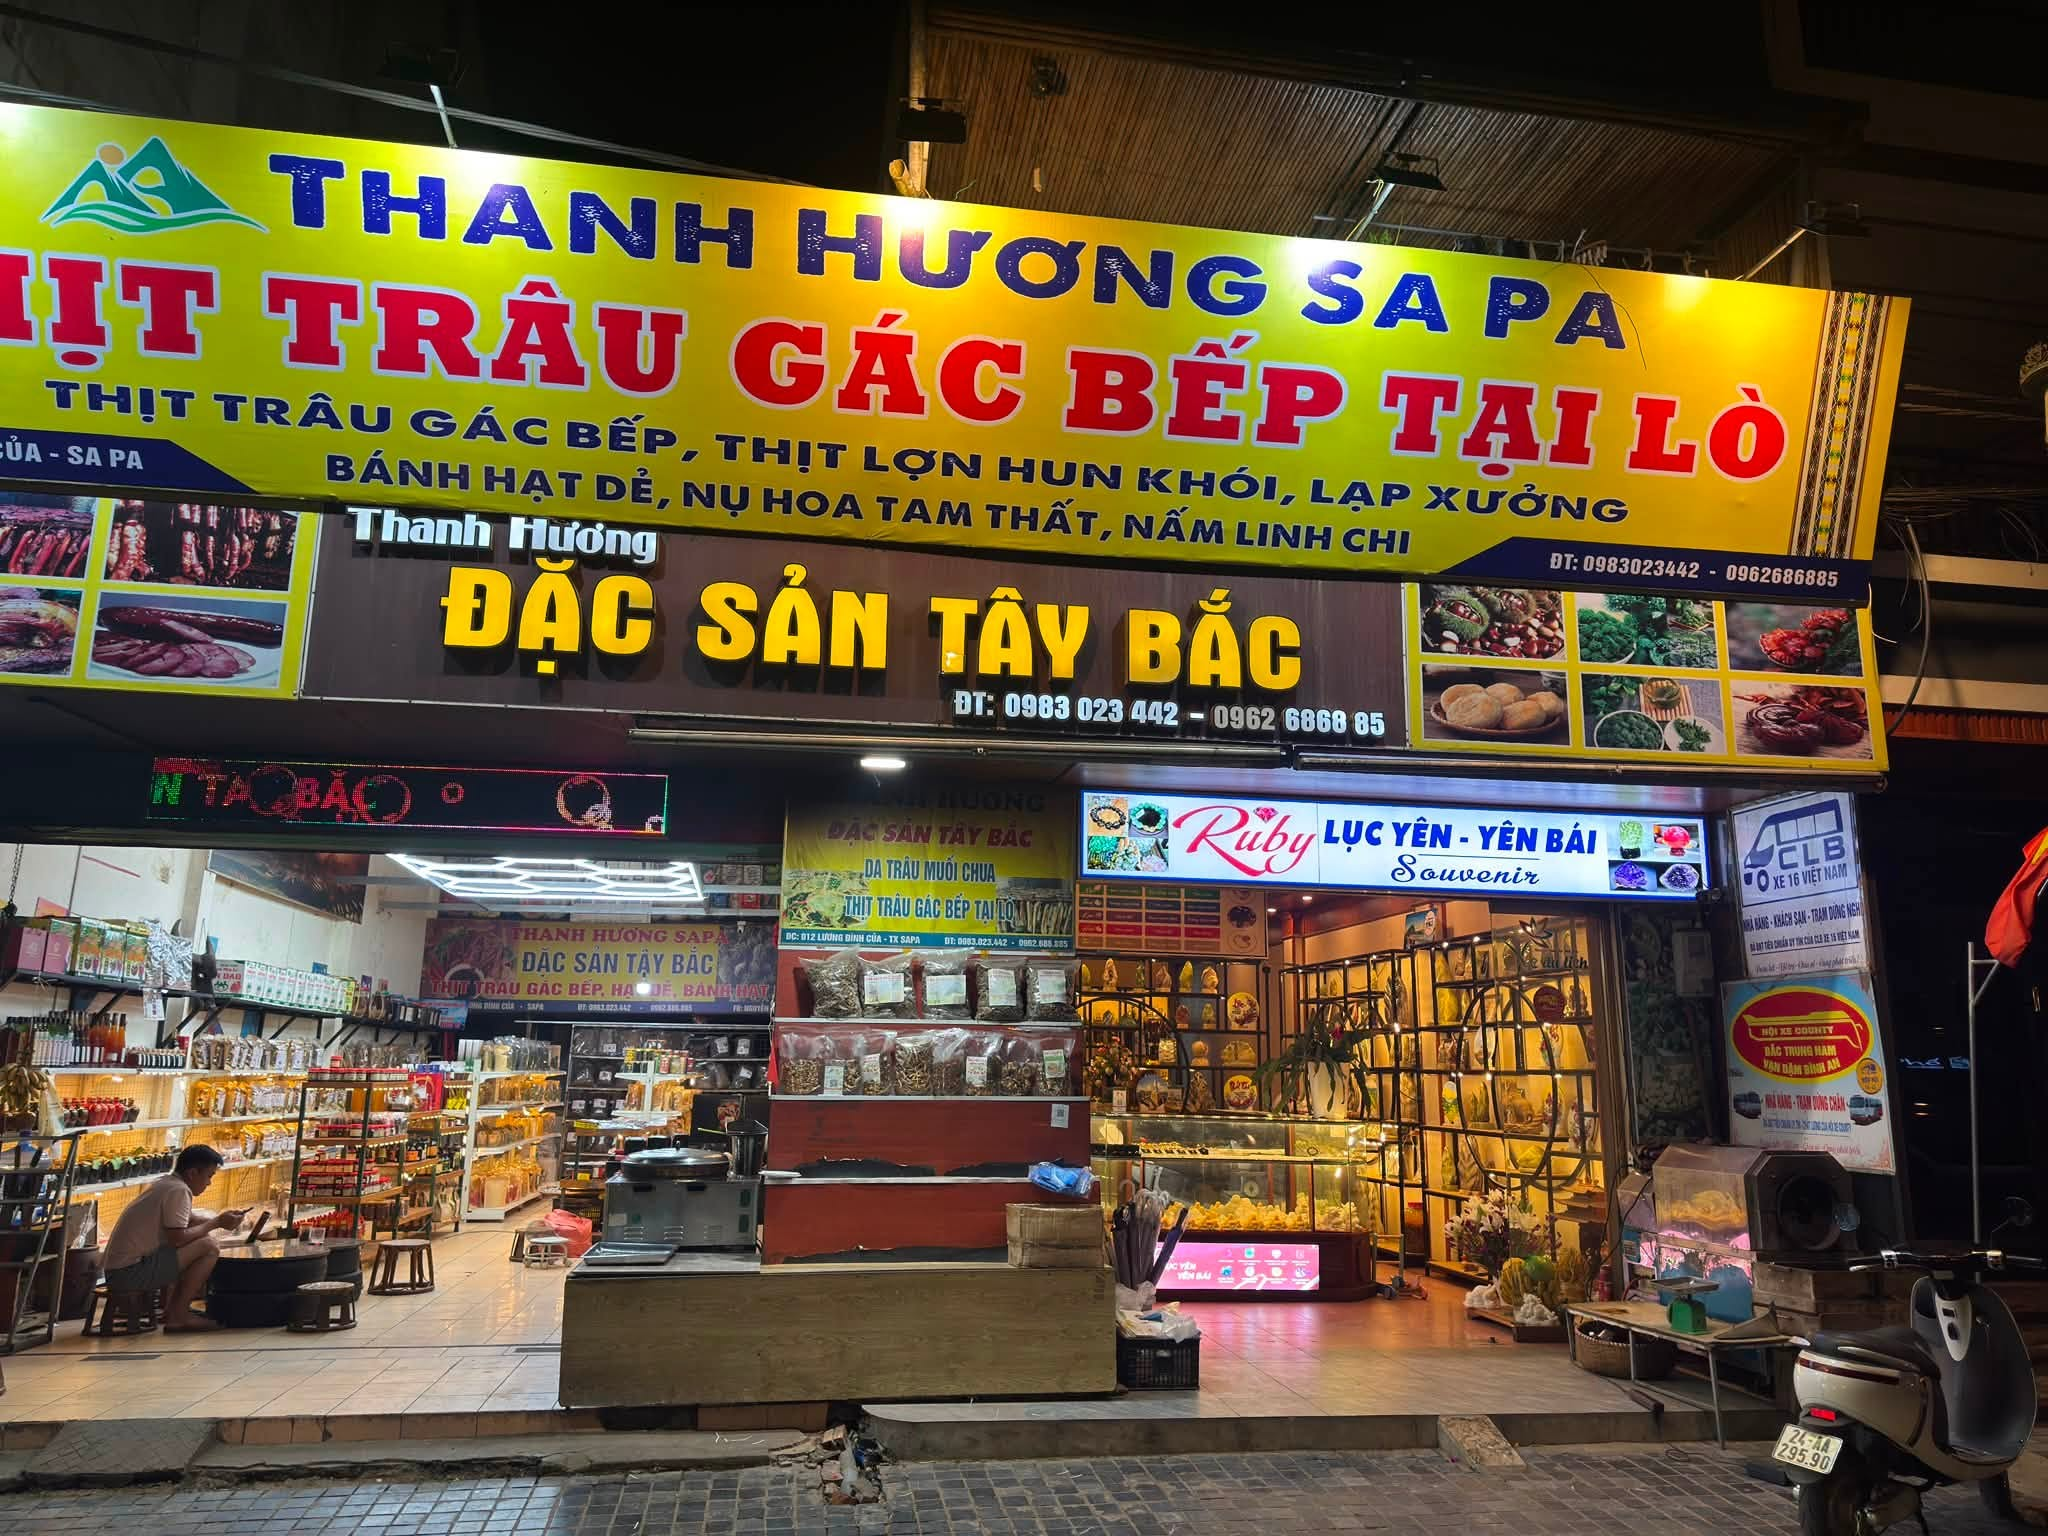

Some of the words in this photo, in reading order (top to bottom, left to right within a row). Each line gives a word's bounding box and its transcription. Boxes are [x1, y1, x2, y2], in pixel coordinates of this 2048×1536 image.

[268, 153, 754, 269] THANH
[797, 207, 1267, 316] HƯƠNG
[1300, 259, 1448, 333] SA
[1483, 276, 1627, 350] PA
[265, 275, 685, 394] TRÂU
[732, 311, 1025, 423] GÁC
[1064, 332, 1346, 447] BẾP
[1382, 373, 1599, 480] TẠI
[1627, 385, 1786, 481] LÒ
[45, 380, 195, 424] THỊT
[213, 393, 392, 434] TRÂU
[410, 407, 551, 448] GÁC
[565, 413, 699, 463] BẾP,
[715, 433, 848, 474] THỊT
[863, 447, 983, 482] LỢN
[998, 455, 1122, 494] HUN
[1136, 465, 1295, 506] KHÓI,
[1309, 477, 1411, 514] LẠP
[1423, 483, 1630, 523] XƯỞNG
[66, 445, 103, 467] SA
[108, 448, 144, 470] PA
[325, 450, 470, 492] BÁNH
[483, 465, 578, 507] HẠT
[594, 466, 671, 512] DẺ,
[681, 482, 752, 517] NỤ
[761, 488, 864, 522] HOA
[875, 495, 973, 529] TAM
[983, 497, 1111, 543] THẤT,
[1122, 506, 1224, 546] NẤM
[1234, 519, 1331, 552] LINH
[1341, 526, 1411, 555] CHI
[347, 506, 491, 549] Thanh
[507, 516, 659, 566] Hương
[1549, 552, 1579, 572] ĐT:
[1583, 554, 1700, 579] 0983023442
[1725, 563, 1839, 588] 0962686885
[440, 557, 655, 676] ĐẶC
[696, 562, 889, 669] SẢN
[929, 585, 1090, 679] TÂY
[1126, 587, 1302, 691] BẮC
[953, 690, 995, 717] ĐT:
[1004, 692, 1070, 720] 0983
[1077, 695, 1124, 723] 023
[1130, 699, 1179, 727] 442
[1213, 703, 1276, 731] 0962
[1284, 707, 1347, 735] 6868
[1354, 710, 1386, 737] 85
[1172, 801, 1318, 877] Ruby
[1323, 819, 1383, 859] LỤC
[1392, 815, 1453, 849] YÊN
[1480, 819, 1545, 852] YÊN
[1546, 820, 1597, 855] BÁI
[1777, 835, 1846, 871] CLB
[864, 858, 882, 879] DA
[886, 856, 920, 880] TRÂU
[924, 855, 957, 882] MUỐI
[962, 862, 996, 883] CHUA
[1390, 853, 1541, 886] Souvenir
[1773, 875, 1785, 890] XE
[1788, 873, 1800, 887] 16
[1801, 866, 1822, 888] VIỆT
[1824, 863, 1847, 881] NAM
[877, 893, 910, 919] TRÂU
[915, 894, 941, 919] GÁC
[512, 926, 586, 943] THANH
[674, 929, 729, 945] SAPA
[1777, 1442, 1831, 1471] 295.90
[1788, 1429, 1832, 1454] 24-AA
